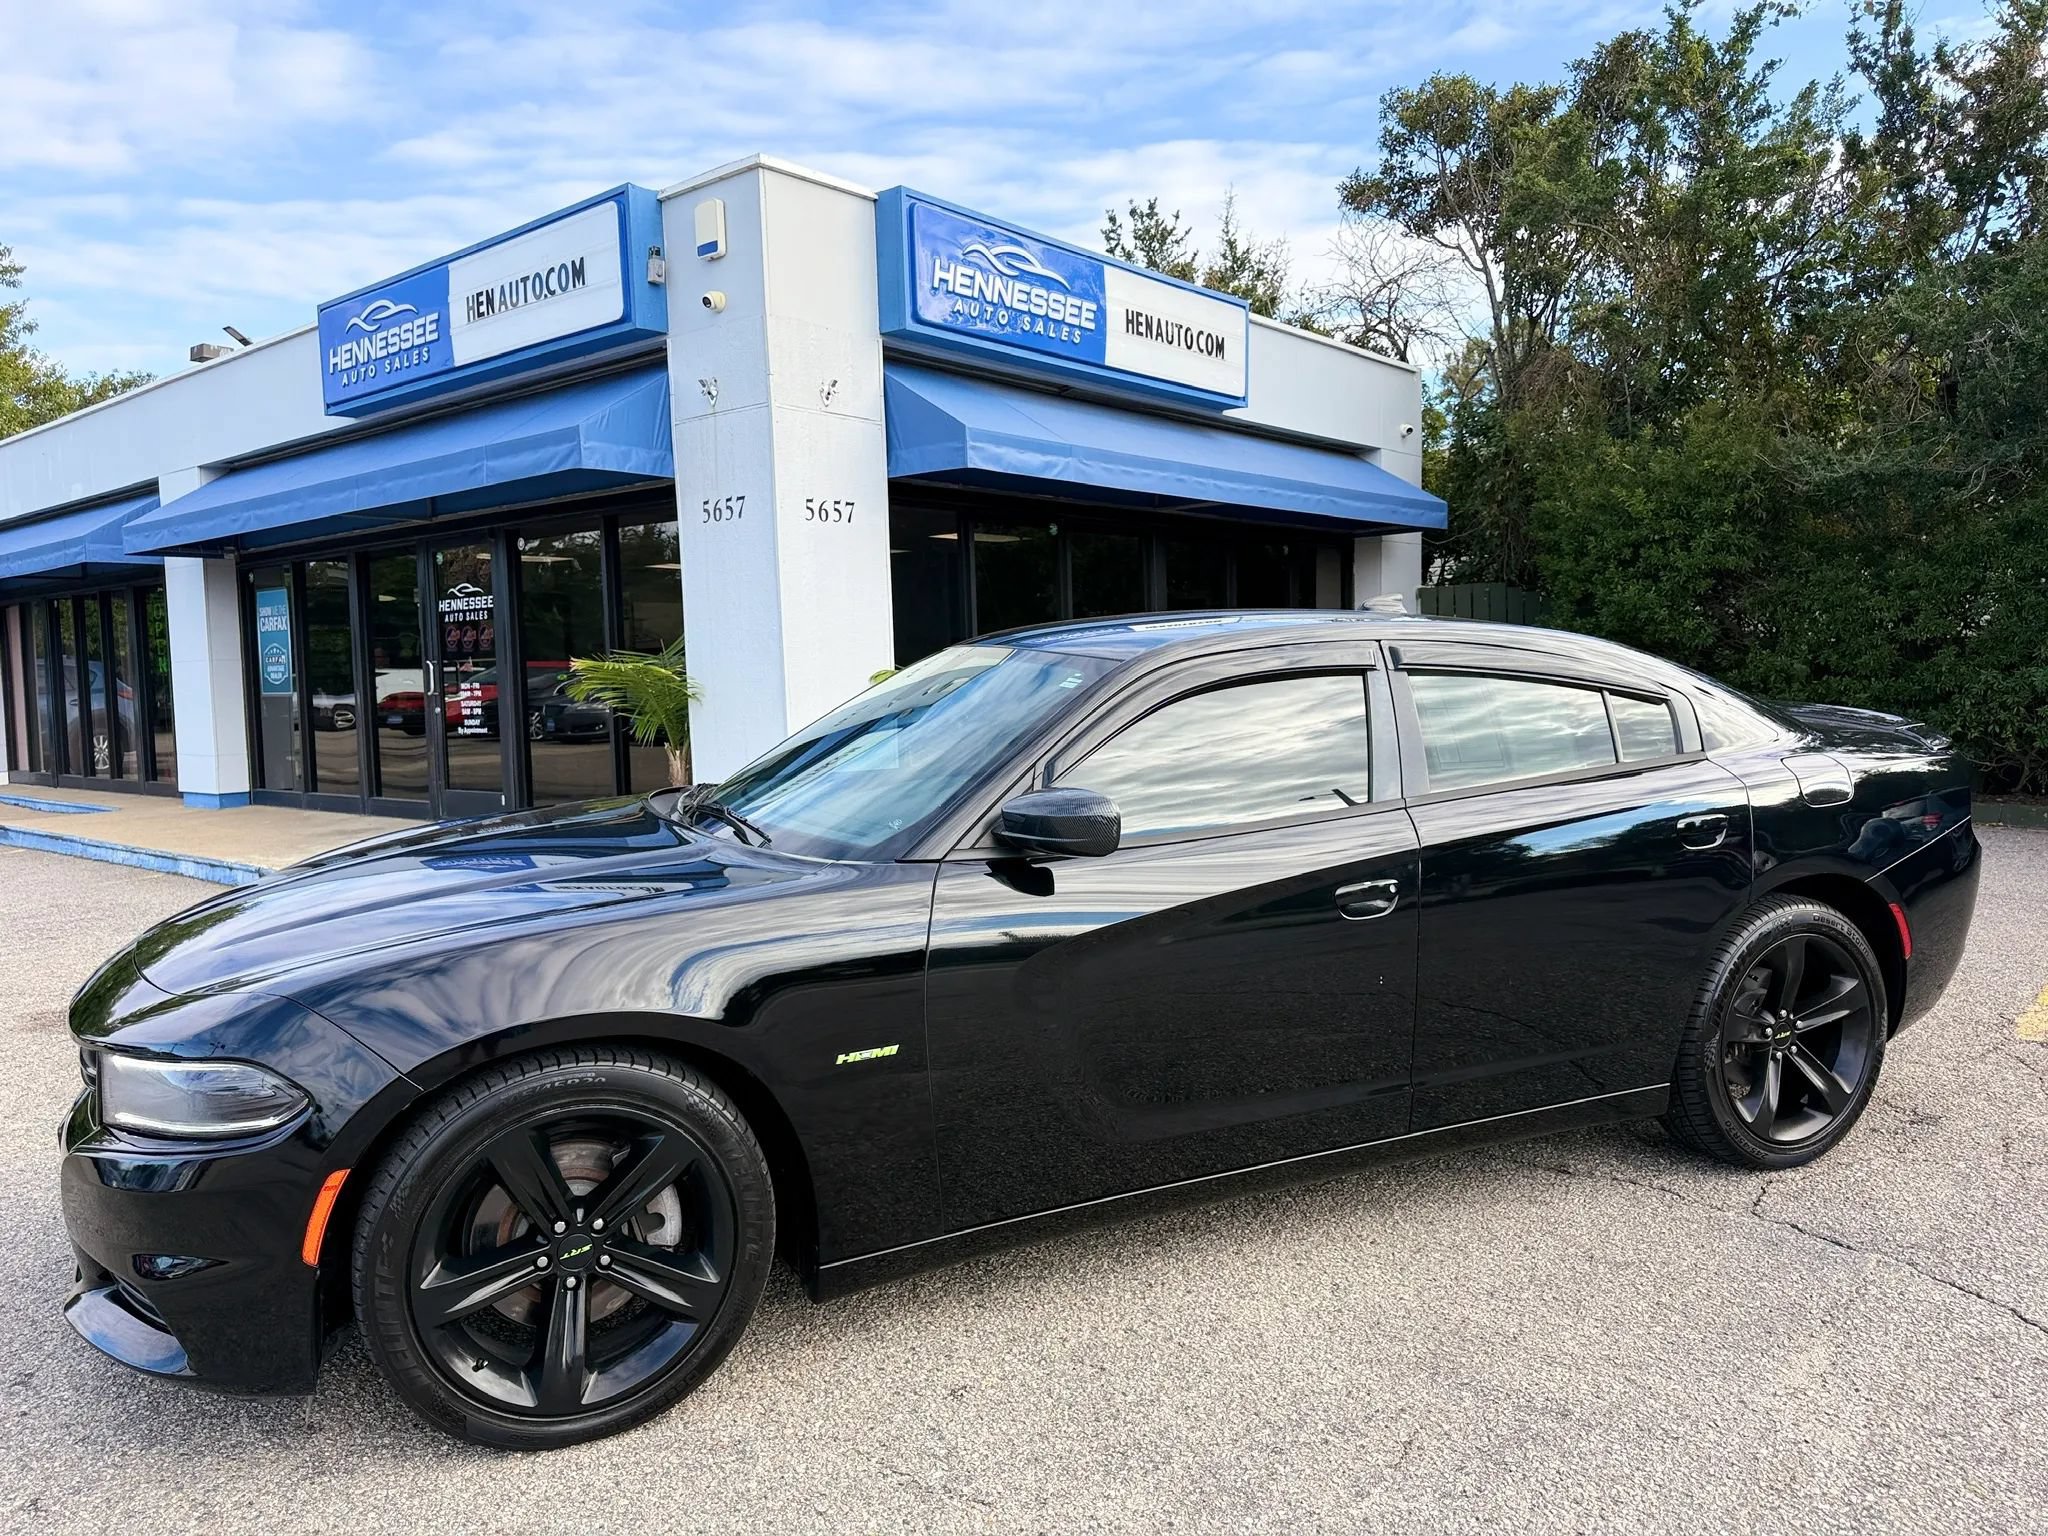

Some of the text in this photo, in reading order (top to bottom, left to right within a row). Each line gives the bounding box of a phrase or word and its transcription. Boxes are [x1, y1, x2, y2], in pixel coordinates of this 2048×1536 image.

[932, 256, 1097, 332] HENNESSEE
[953, 299, 1082, 345] AUTO SALES
[329, 312, 440, 376] HENNESSEE
[341, 346, 430, 388] AUTO SALES
[702, 495, 746, 524] 5657
[805, 498, 855, 524] 5657
[259, 606, 272, 616] SHOW
[439, 595, 494, 613] HENNESSEE
[444, 610, 488, 623] AUTO SALES
[260, 615, 288, 632] CARFAX
[464, 726, 488, 735] Appointment
[1813, 914, 1869, 957] Desert Storm
[559, 1243, 594, 1262] SRT
